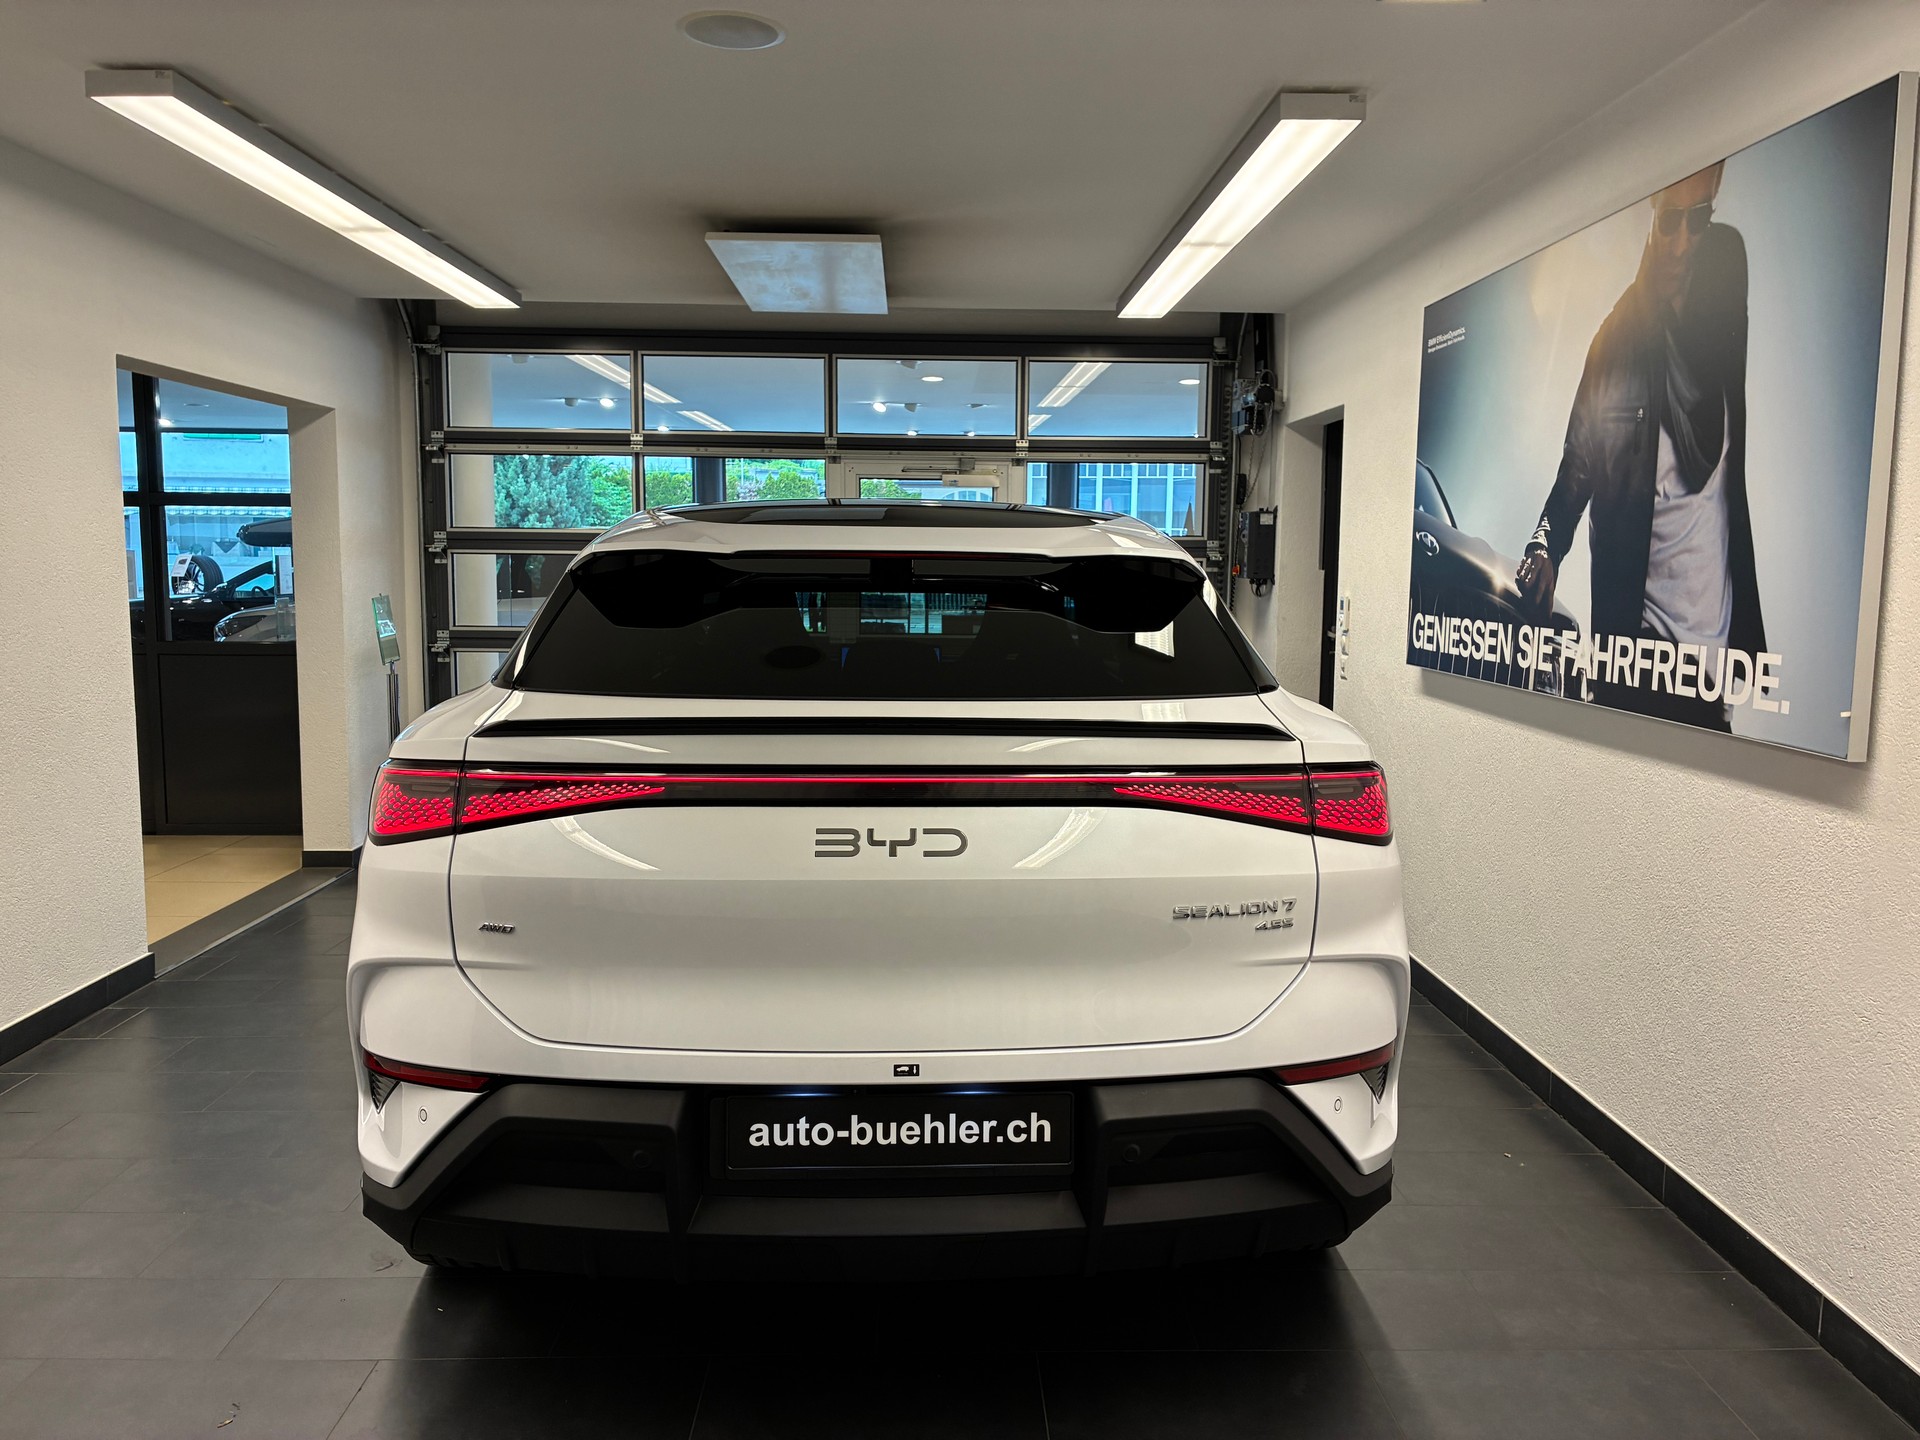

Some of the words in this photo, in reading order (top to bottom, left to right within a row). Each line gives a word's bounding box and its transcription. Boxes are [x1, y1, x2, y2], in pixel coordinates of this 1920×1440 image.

[1412, 612, 1513, 665] GENIESSEN
[1517, 624, 1555, 673] SIE
[1560, 629, 1790, 715] FAHRFREUDE.
[815, 828, 968, 857] BYD
[1172, 900, 1279, 920] SEALION
[1281, 897, 1298, 913] 7
[478, 922, 515, 934] AWD
[749, 1112, 1051, 1147] auto-buehler.ch
